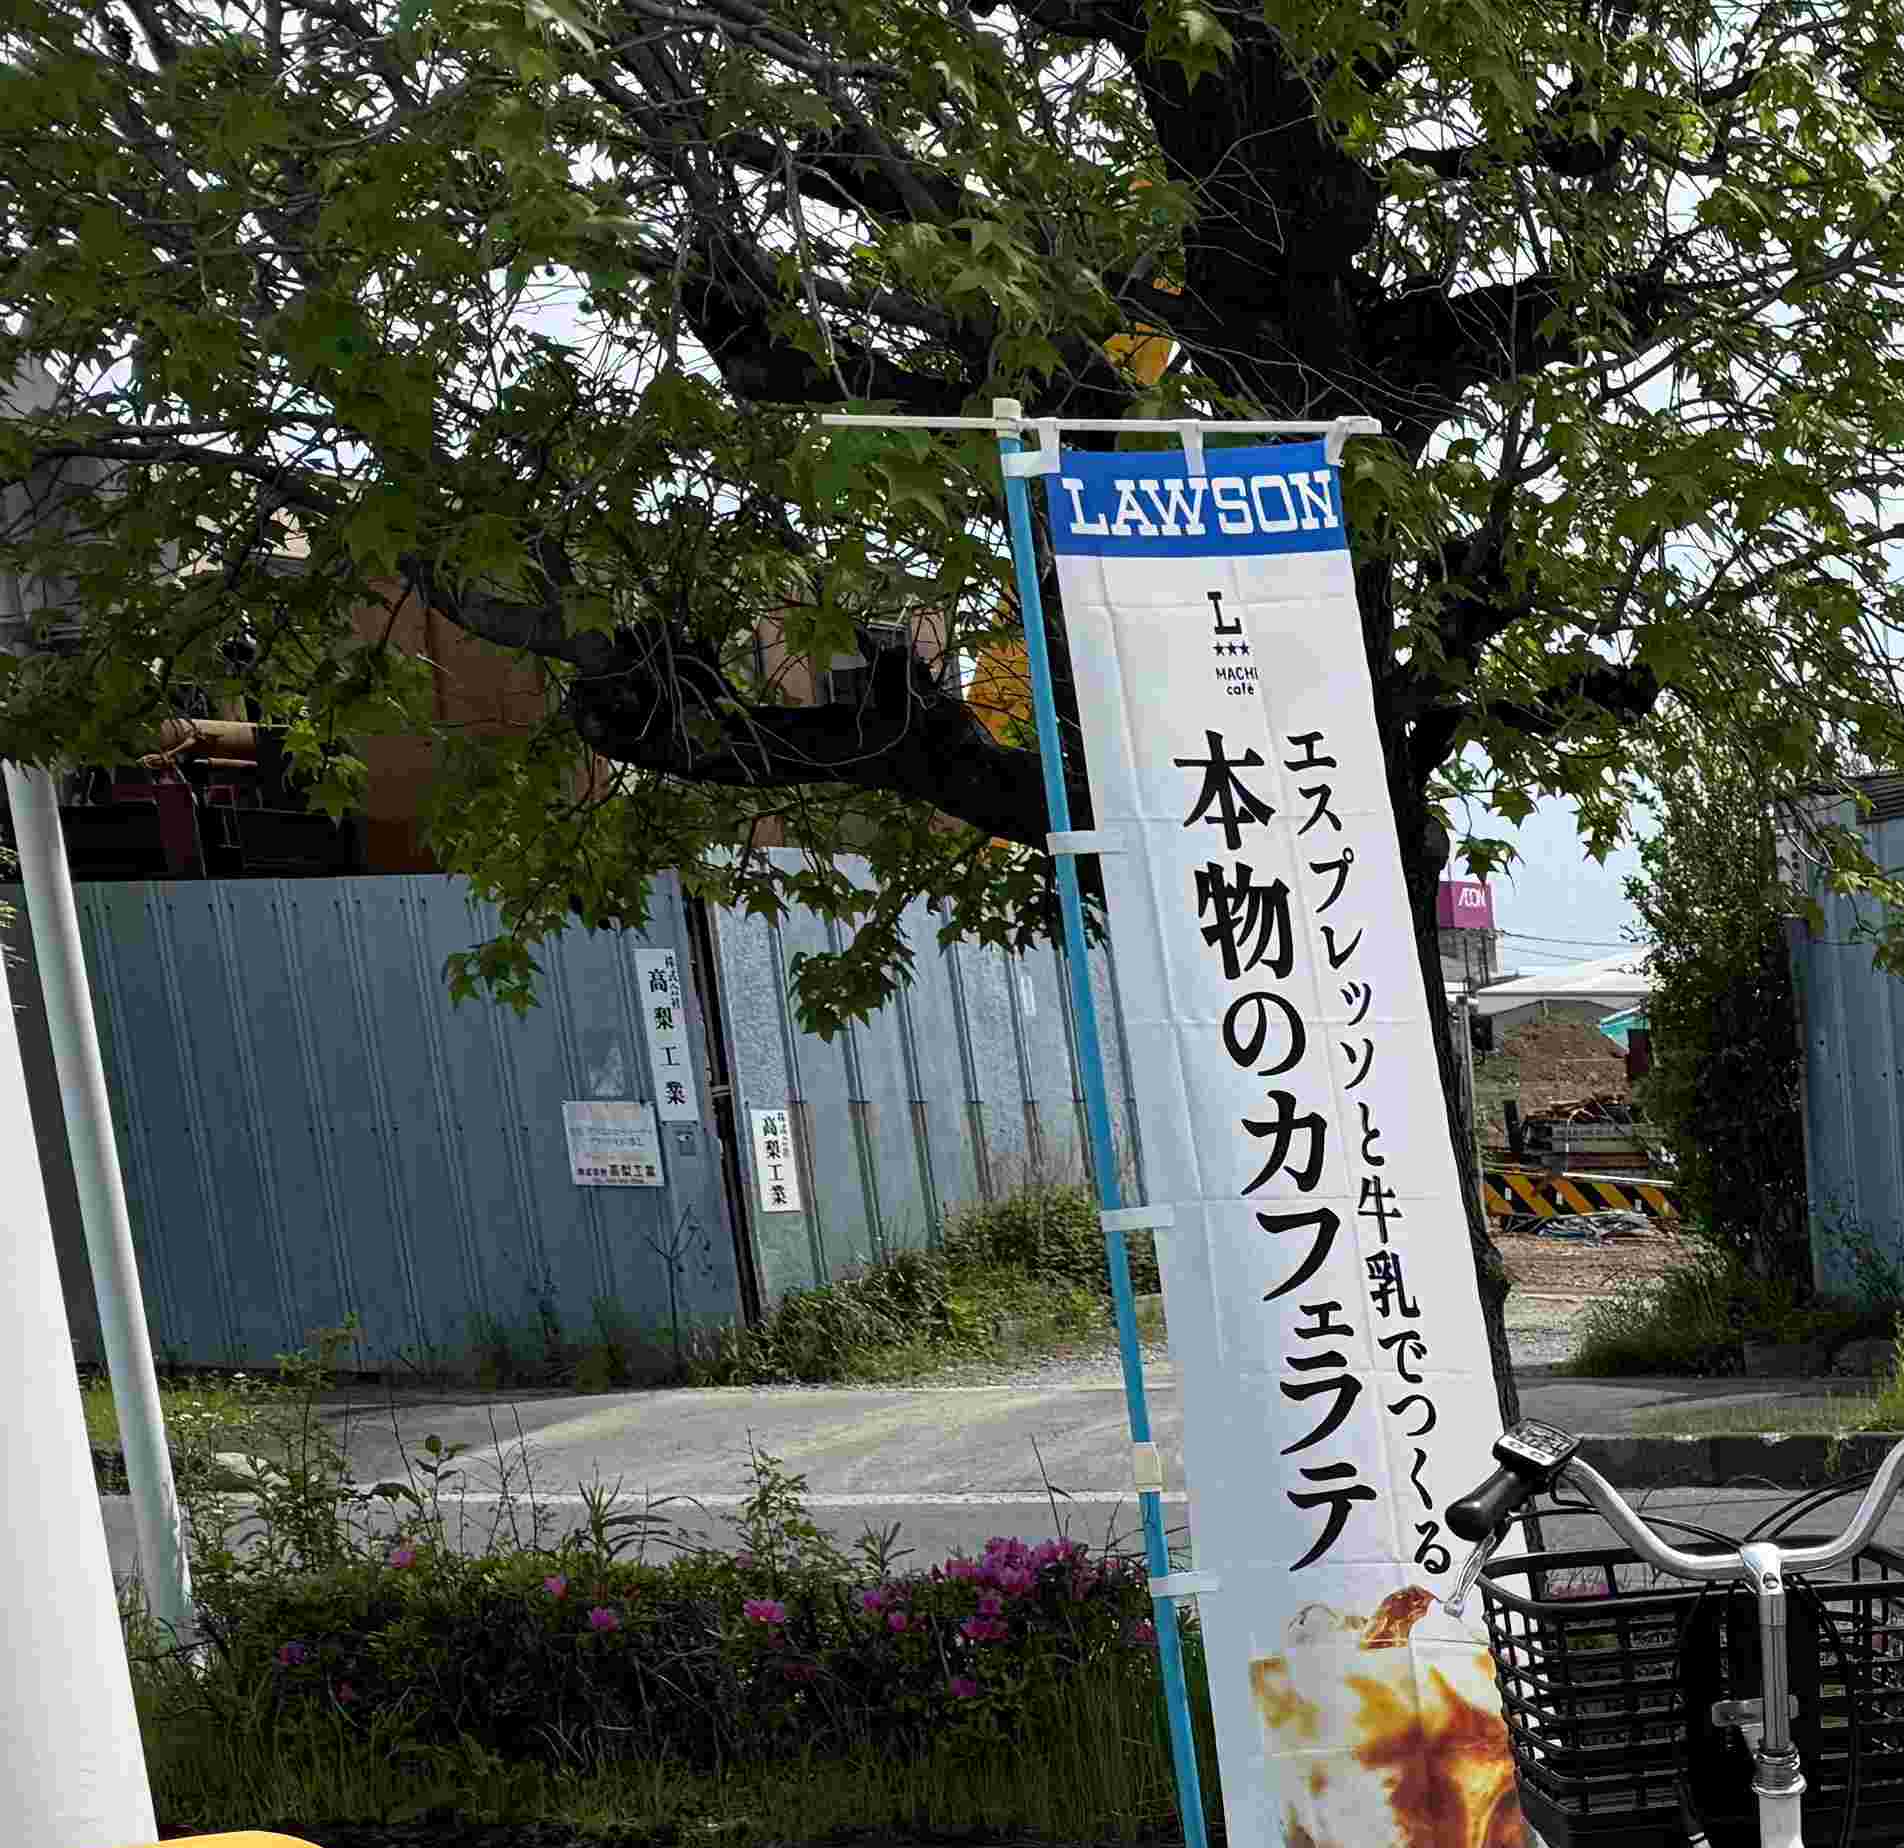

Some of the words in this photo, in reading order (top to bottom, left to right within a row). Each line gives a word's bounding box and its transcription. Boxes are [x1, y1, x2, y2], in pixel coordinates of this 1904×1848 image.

[1061, 467, 1339, 537] LAWSON
[1215, 665, 1258, 682] MACHI
[647, 968, 688, 1105] 高梨工業
[762, 1115, 787, 1206] 高梨工業
[1173, 730, 1377, 1572] 本物のカフェラテ
[1283, 730, 1452, 1574] エスプレッソと牛乳でつくる
